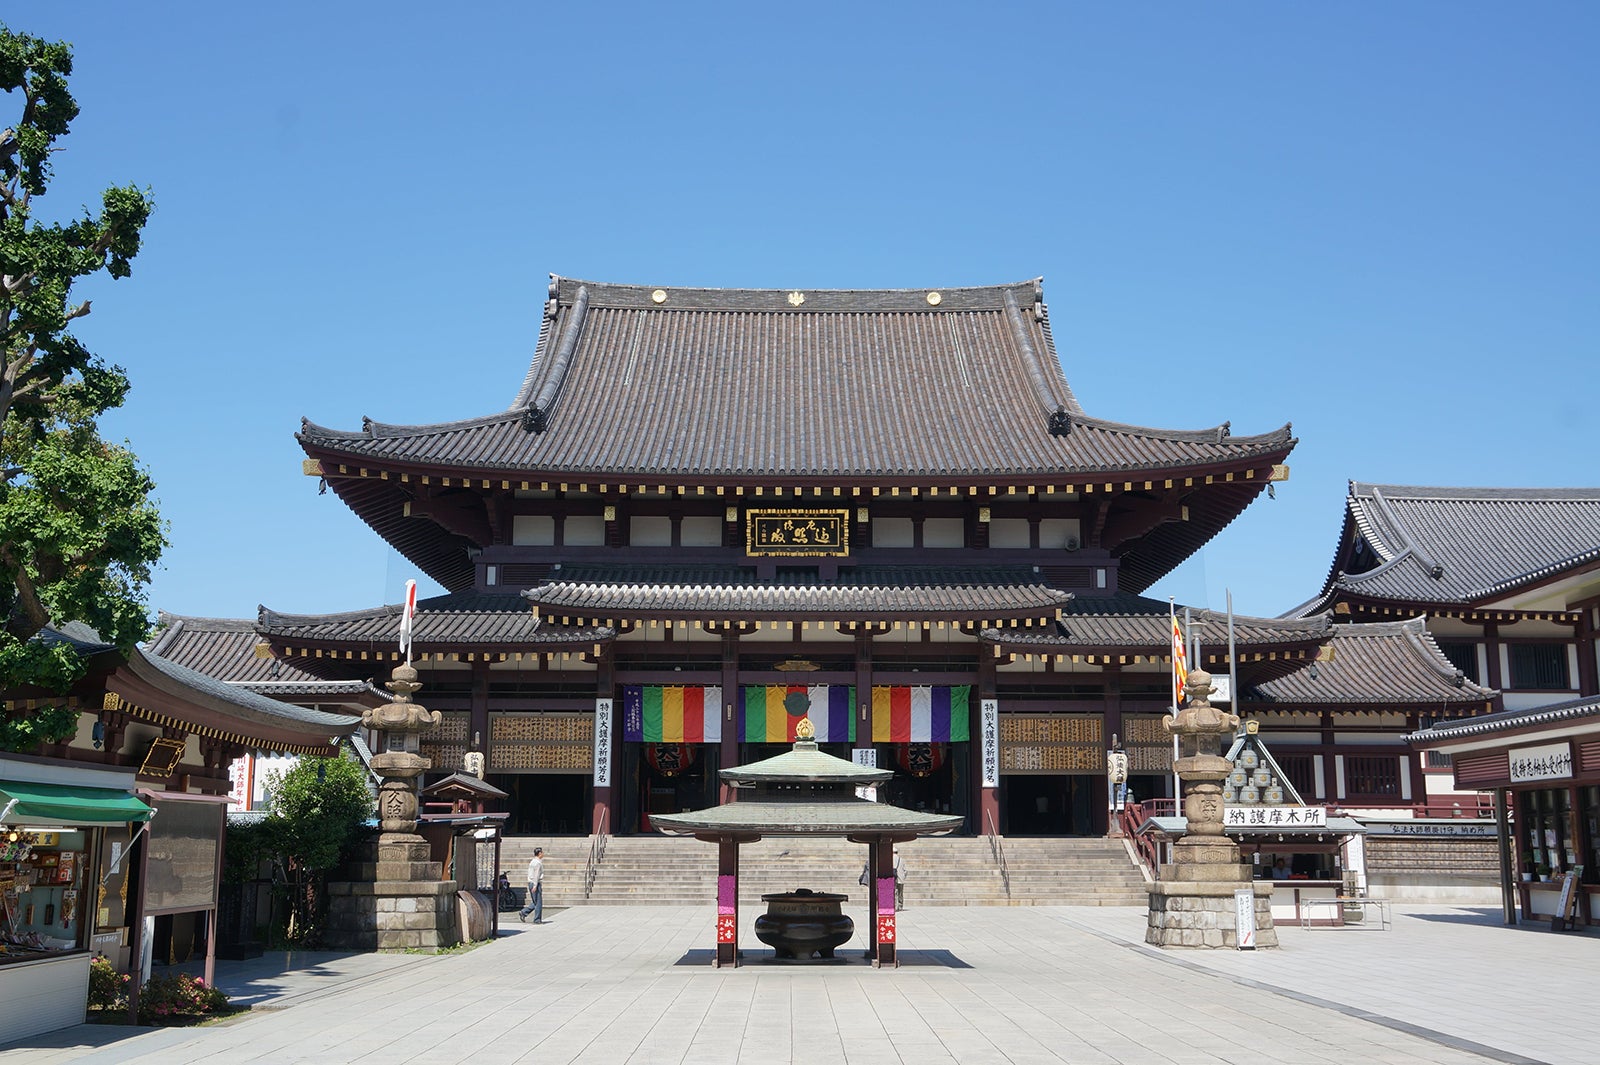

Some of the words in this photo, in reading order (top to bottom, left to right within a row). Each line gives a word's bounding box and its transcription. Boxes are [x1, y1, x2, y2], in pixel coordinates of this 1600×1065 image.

[597, 702, 610, 783] 特別大護摩祈願芳名
[984, 703, 996, 783] 特別大護摩祈願芳名
[1229, 808, 1320, 825] 納護摩木所
